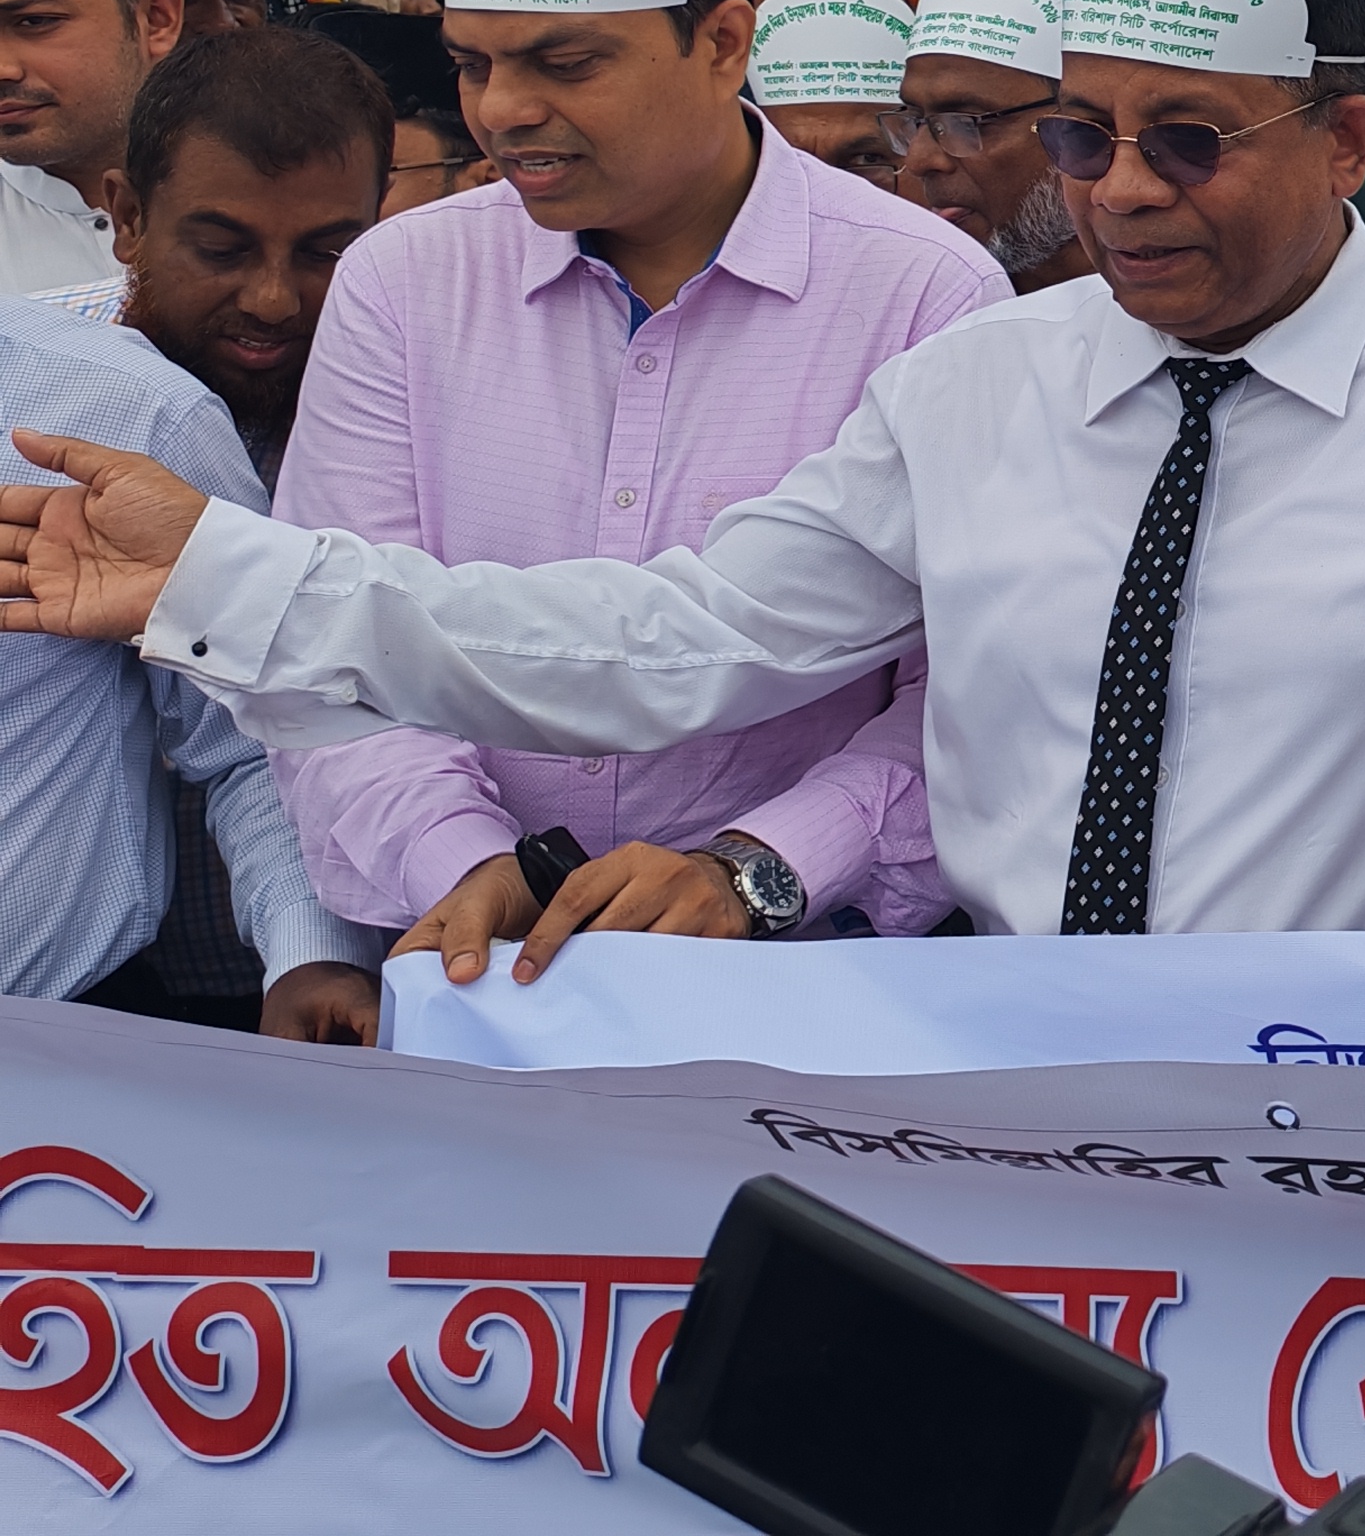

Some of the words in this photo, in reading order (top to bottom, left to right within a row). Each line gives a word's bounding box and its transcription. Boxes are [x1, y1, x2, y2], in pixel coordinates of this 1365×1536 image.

[1080, 10, 1116, 26] বরিশাল
[1120, 11, 1146, 29] সিটি
[1150, 16, 1219, 42] কর্পোরেশন
[1112, 31, 1145, 51] ভিশন
[1150, 39, 1215, 62] বাংলাদেশ
[0, 1144, 318, 1498] হিত
